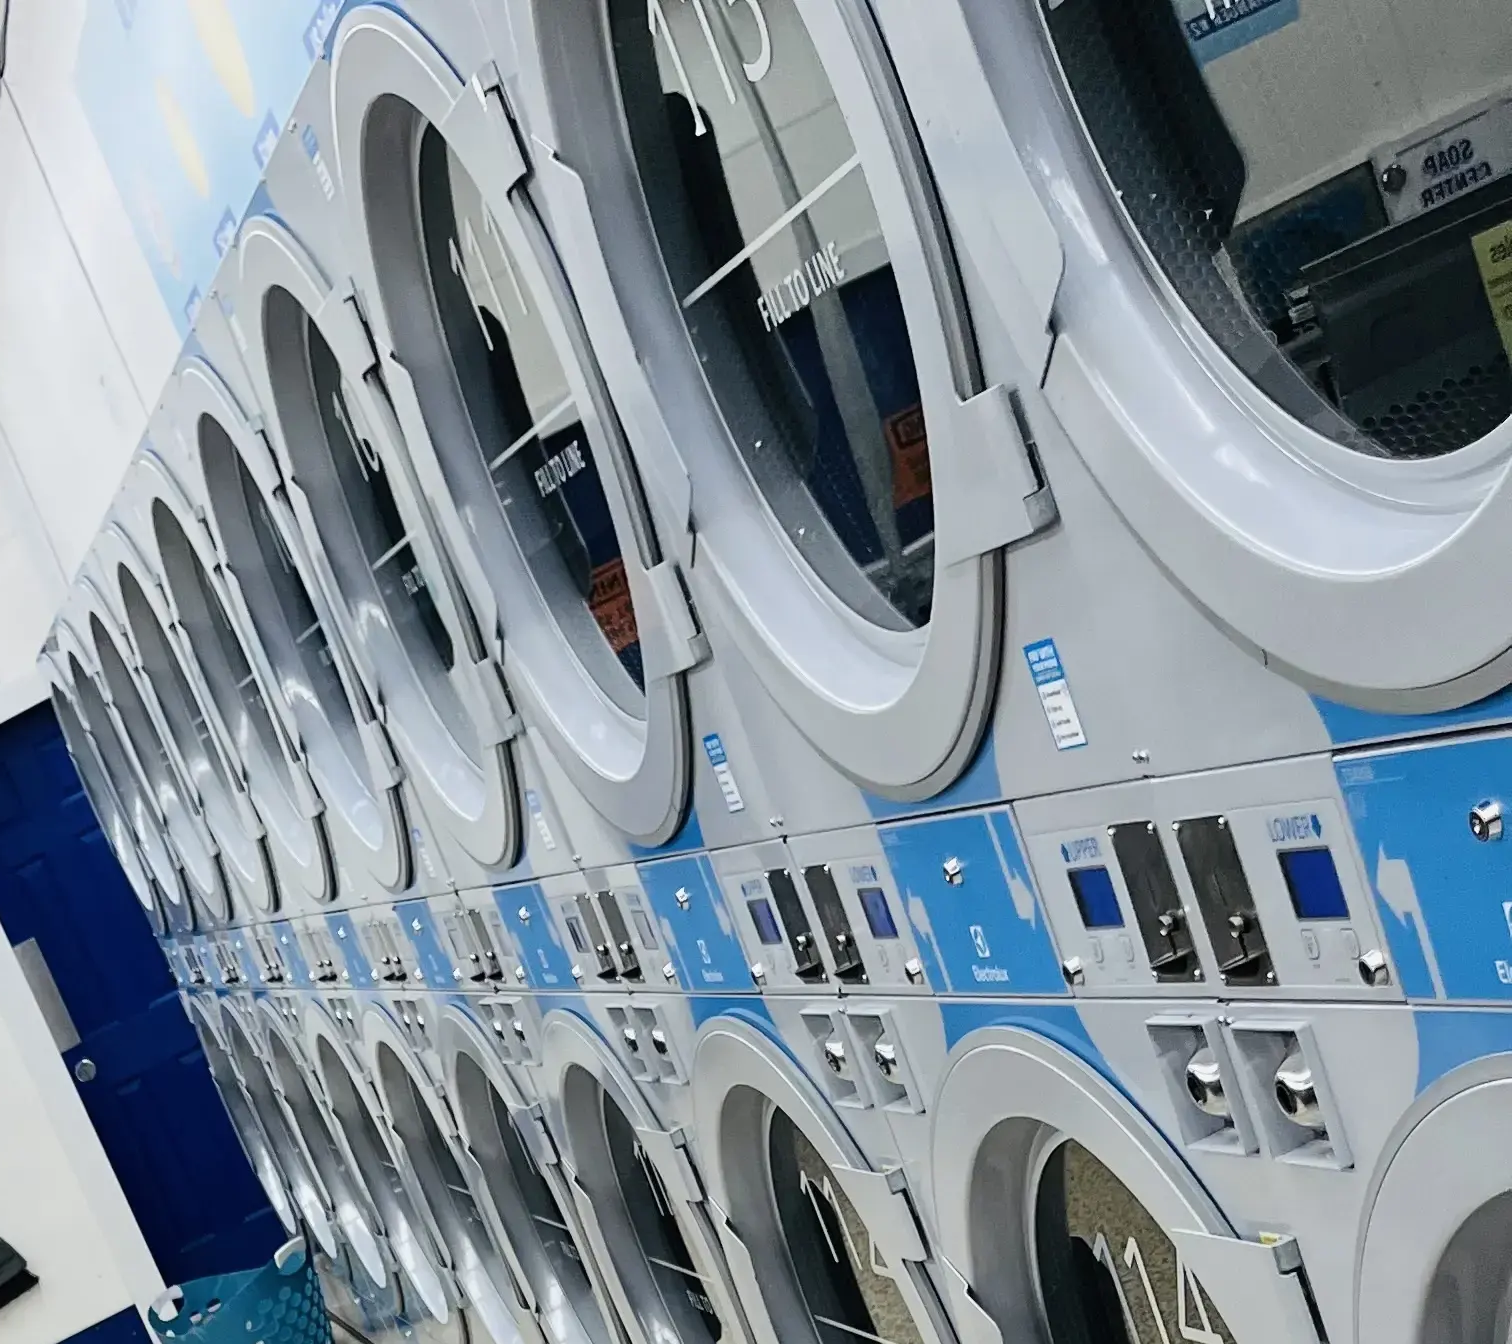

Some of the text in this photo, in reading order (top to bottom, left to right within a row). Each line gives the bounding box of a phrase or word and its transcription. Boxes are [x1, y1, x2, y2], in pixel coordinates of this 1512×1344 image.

[757, 241, 845, 332] FILL TO LINE
